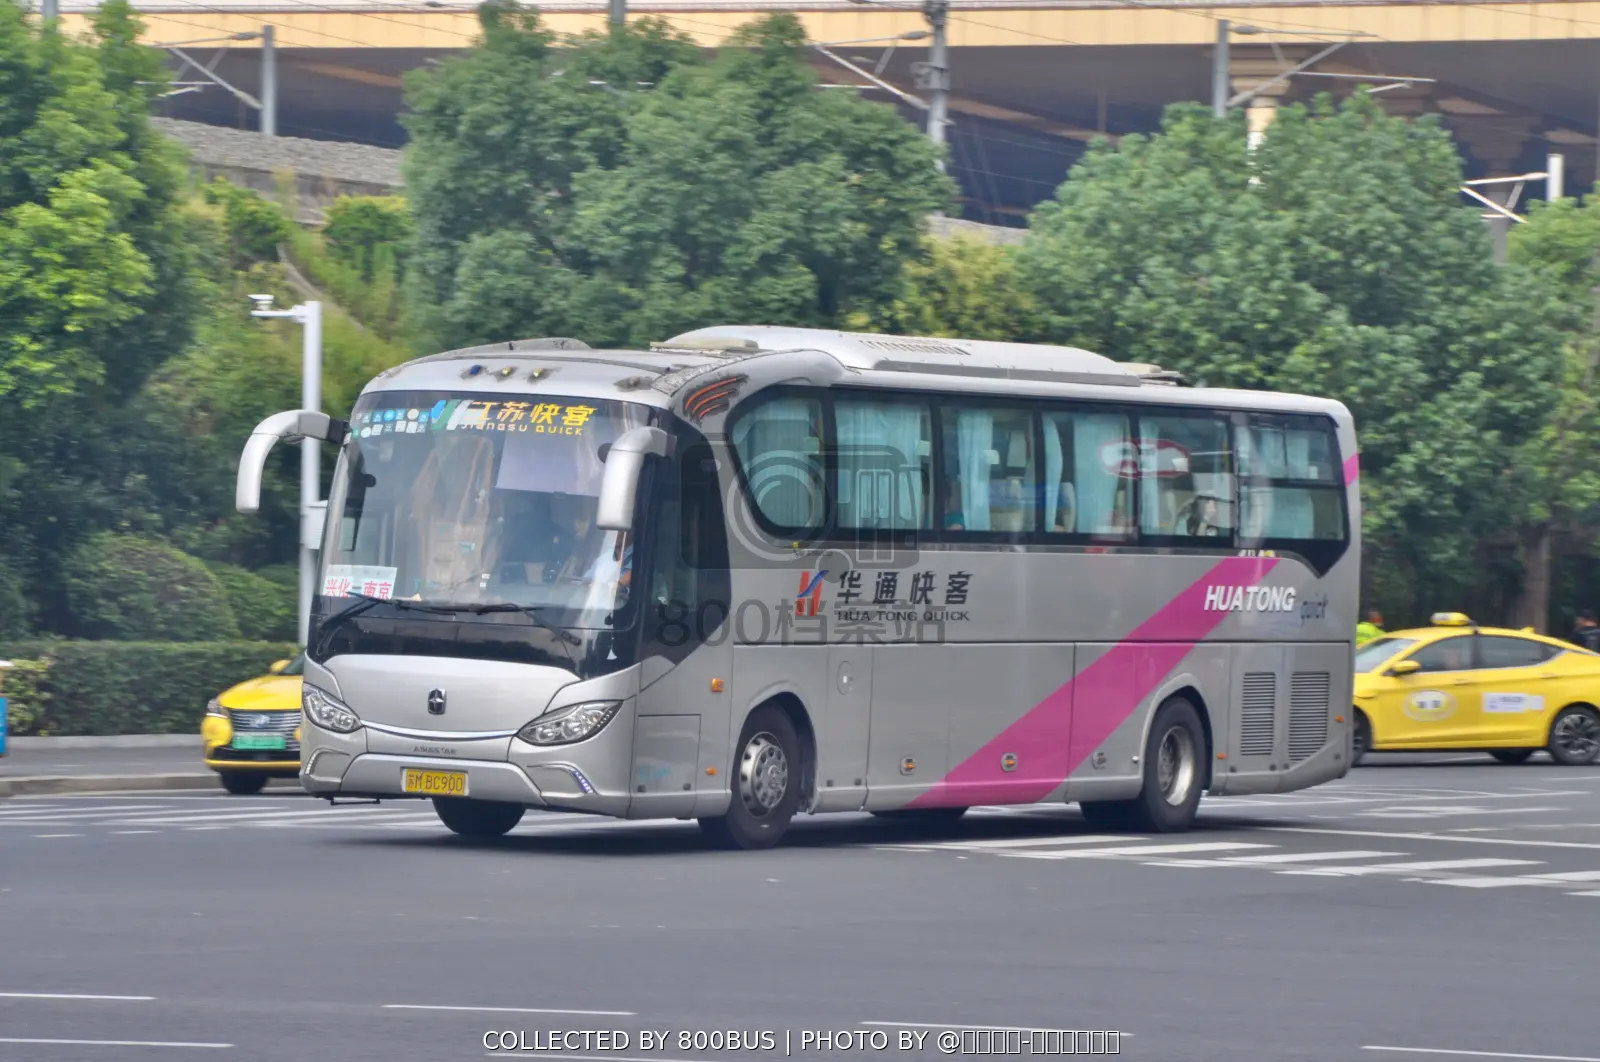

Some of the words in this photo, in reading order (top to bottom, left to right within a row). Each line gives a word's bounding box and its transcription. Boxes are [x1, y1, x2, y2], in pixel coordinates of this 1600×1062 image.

[464, 400, 600, 427] 江苏快客
[836, 570, 974, 605] 华通快客
[1203, 585, 1297, 612] HUATONG
[837, 610, 872, 622] HUA
[877, 610, 918, 622] TONG
[922, 610, 970, 622] QUICK
